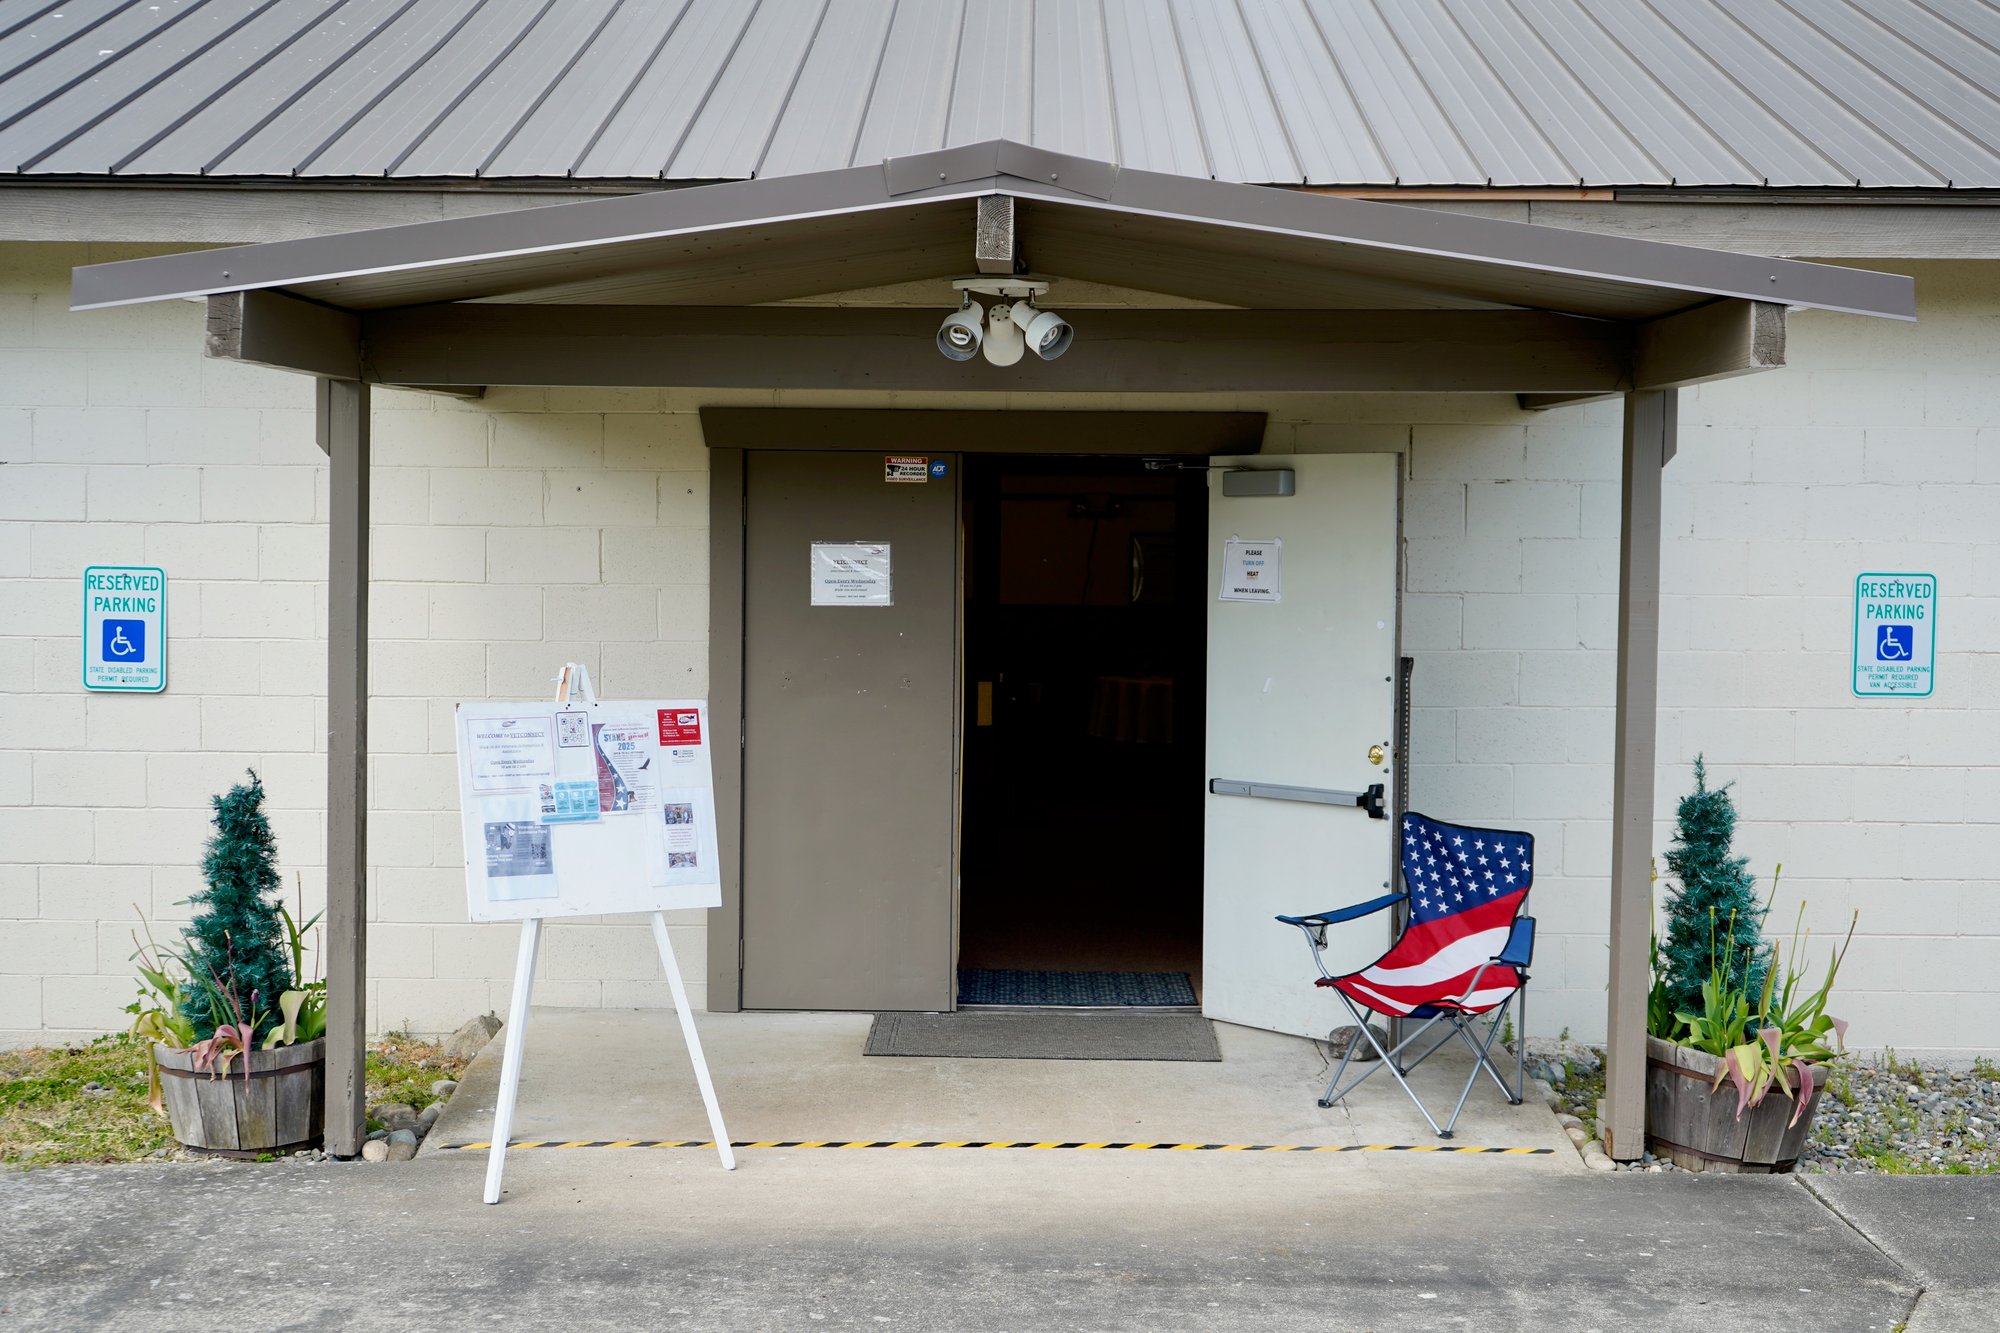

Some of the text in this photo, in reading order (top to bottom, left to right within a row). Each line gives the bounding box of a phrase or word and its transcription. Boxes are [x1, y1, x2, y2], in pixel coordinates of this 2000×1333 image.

[88, 574, 159, 591] RESERVED
[1861, 583, 1931, 598] RESERVED
[94, 597, 156, 613] PARKING
[1867, 604, 1924, 619] PARKING
[618, 742, 636, 750] 2025
